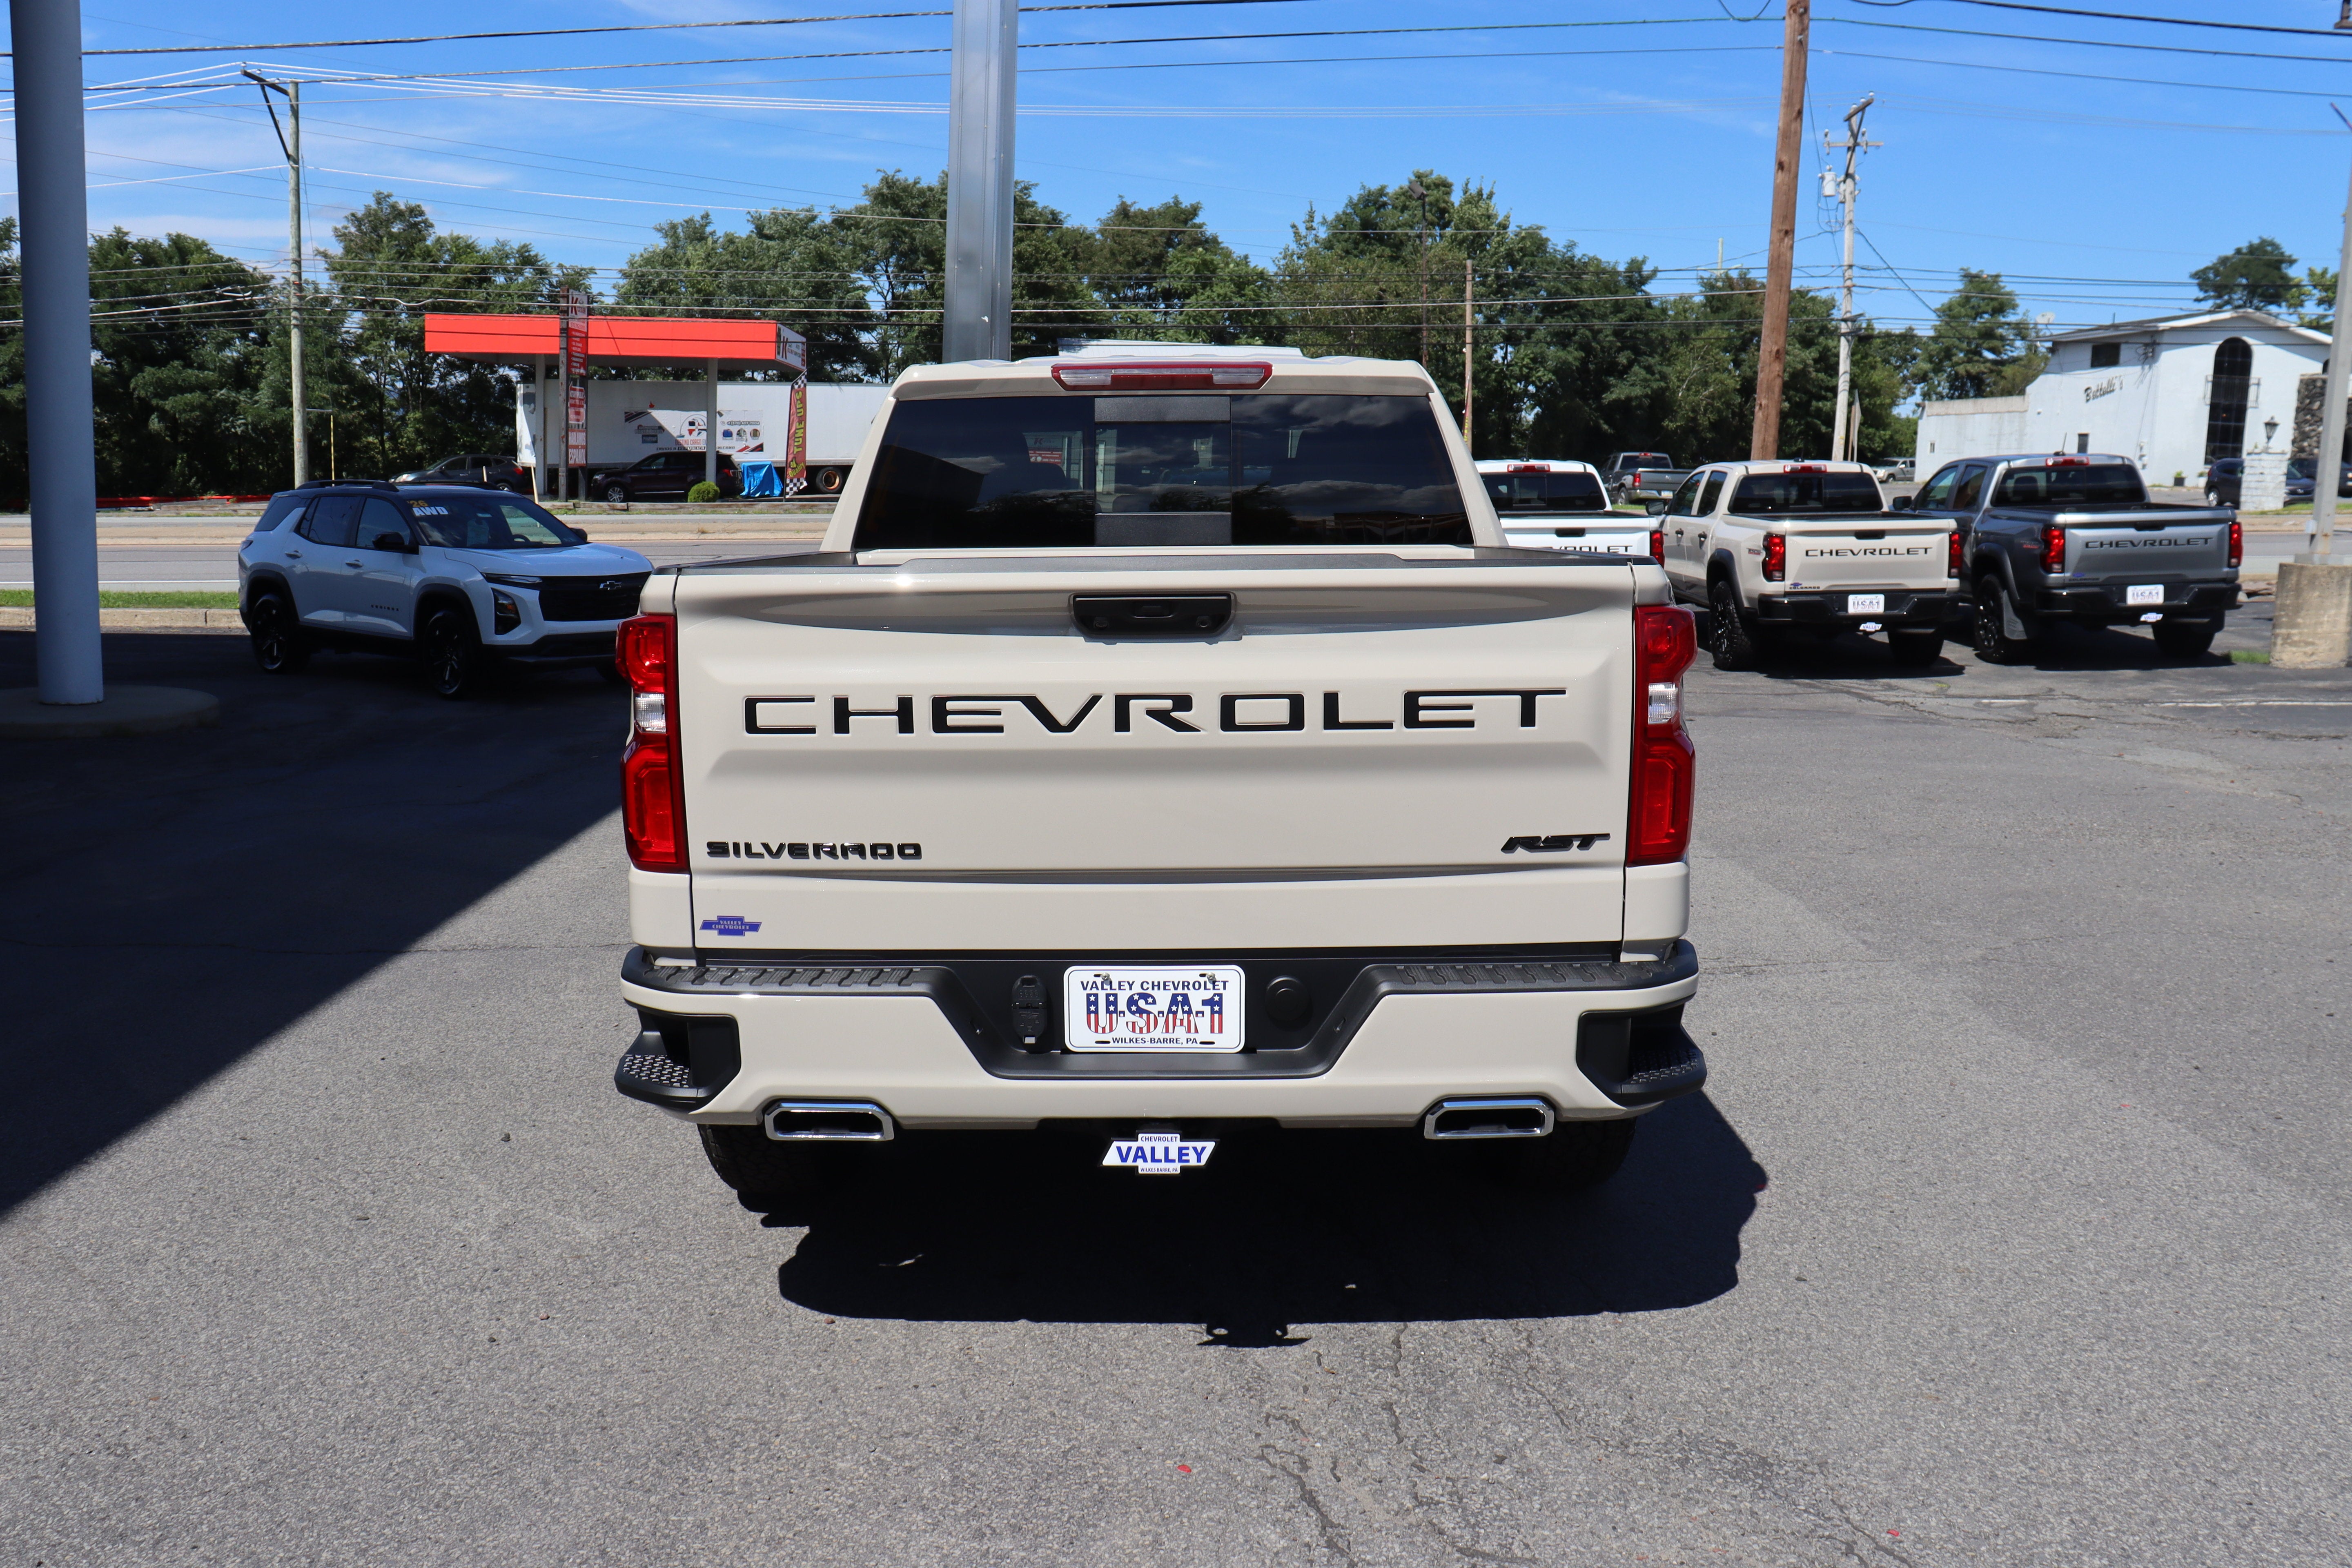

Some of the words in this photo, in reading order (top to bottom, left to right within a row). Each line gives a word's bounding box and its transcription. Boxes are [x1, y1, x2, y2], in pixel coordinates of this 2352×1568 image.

[793, 421, 804, 454] TUNE
[412, 506, 449, 516] AWD
[2085, 537, 2214, 549] CHEVROLET
[1805, 547, 1933, 557] CHEVROLET
[744, 688, 1567, 733] CHEVROLET
[1501, 833, 1611, 854] RST
[707, 842, 922, 860] SILVERADO
[1080, 980, 1135, 991] VALLEY
[1140, 980, 1229, 991] CHEVROLET
[1112, 1037, 1183, 1045] WILKES-BARRE,
[1116, 1146, 1207, 1163] VALLEY
